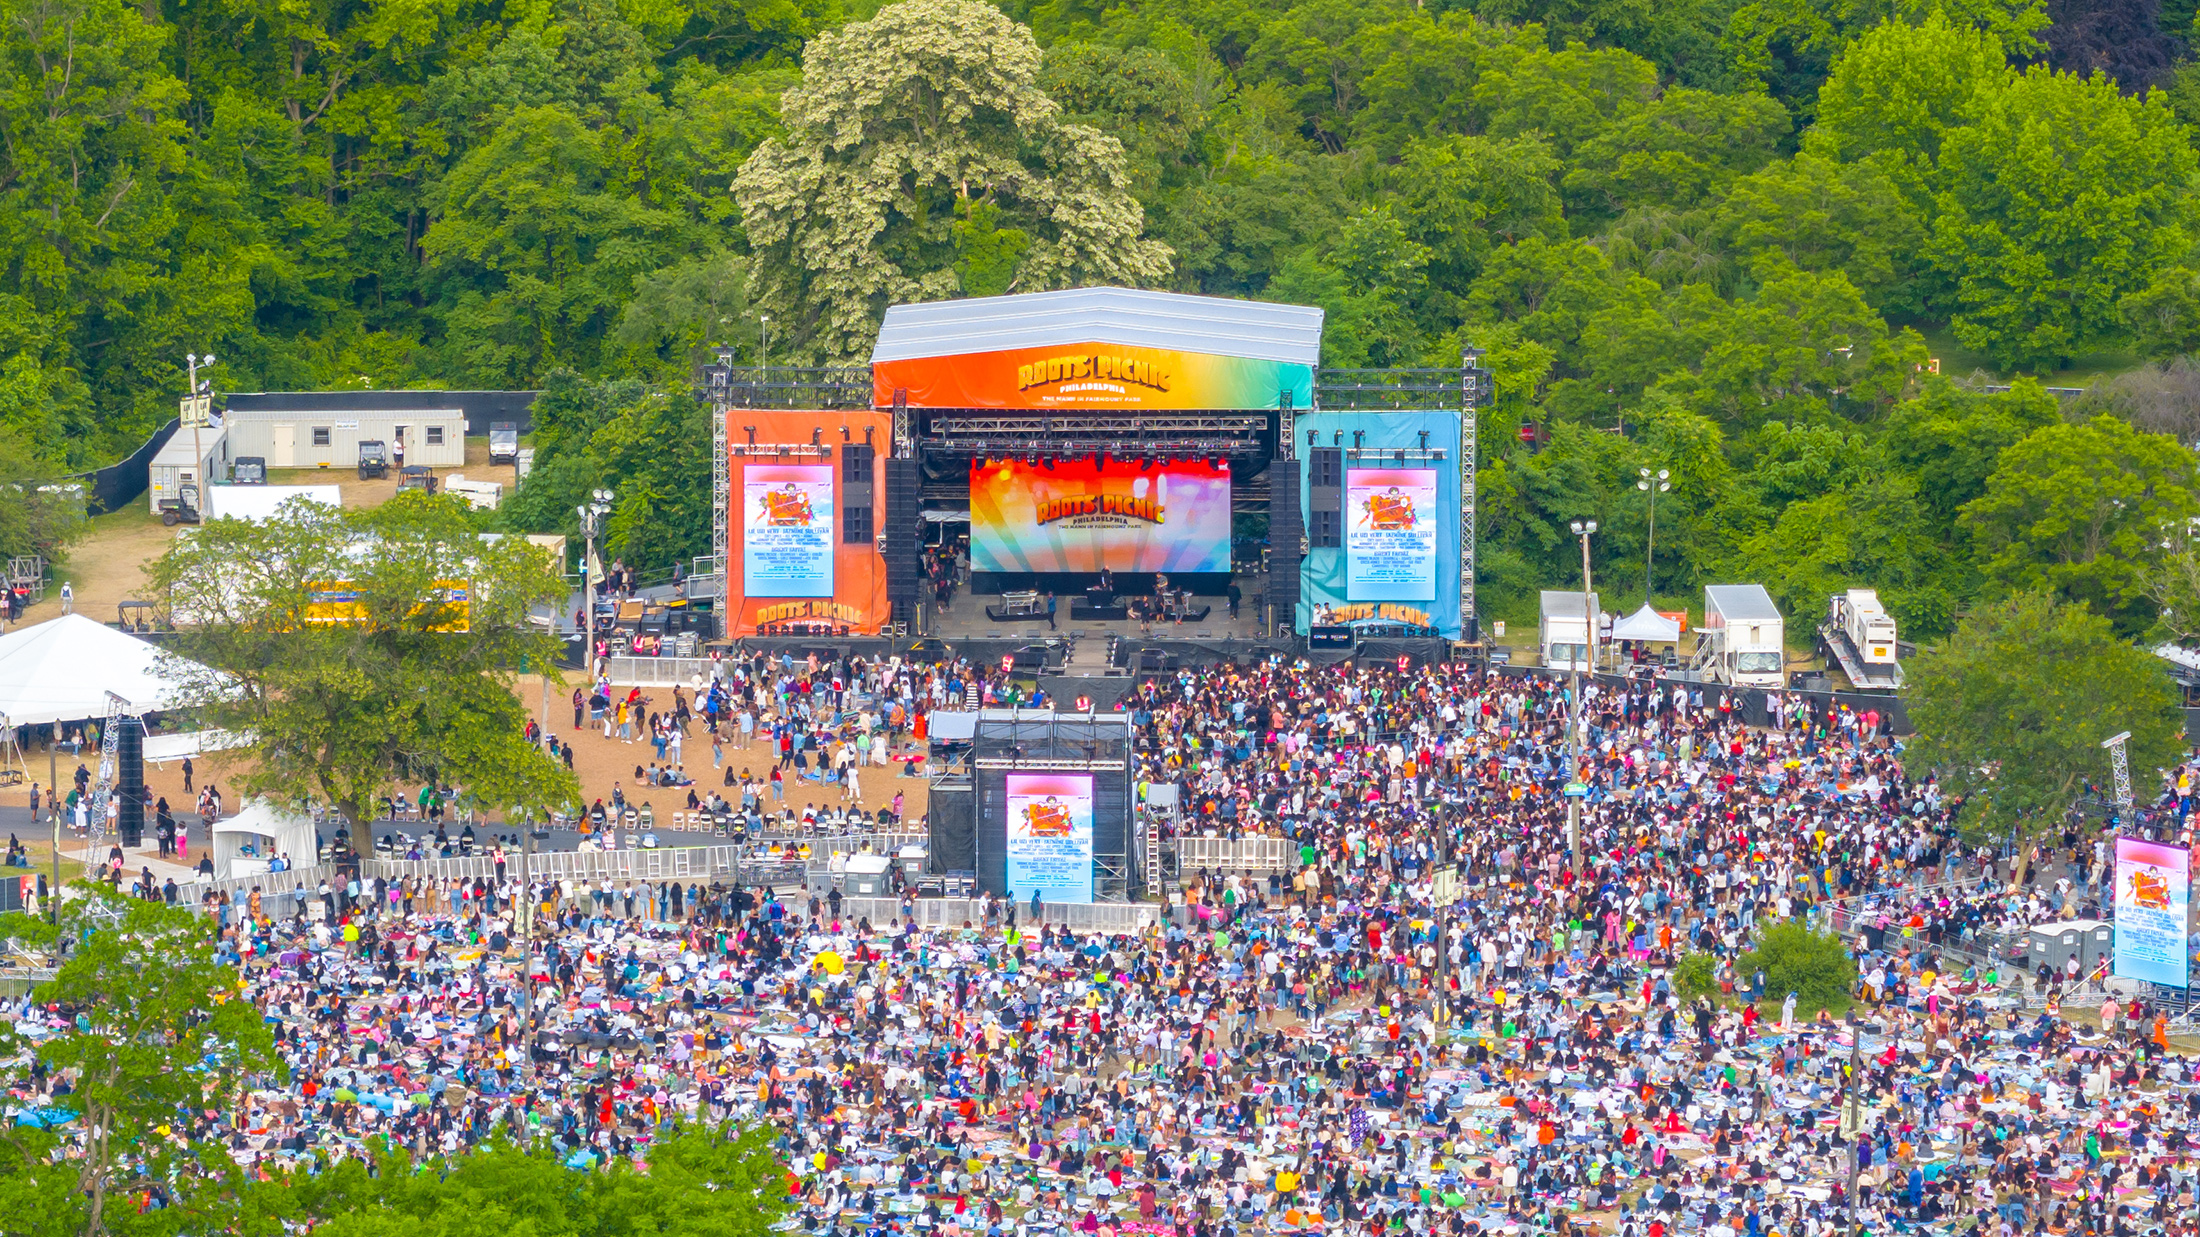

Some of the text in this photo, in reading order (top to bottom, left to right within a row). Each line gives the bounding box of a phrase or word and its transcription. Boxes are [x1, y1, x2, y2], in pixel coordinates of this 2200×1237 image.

[1018, 355, 1171, 392] ROOTS PICNIC
[1060, 383, 1125, 394] PHILADELPHIA
[1036, 494, 1165, 526] ROOTS PICNIC
[1073, 516, 1128, 525] PHILADELPHIA
[757, 601, 863, 626] ROOTS PICNIC
[1378, 603, 1430, 627] PICNIC
